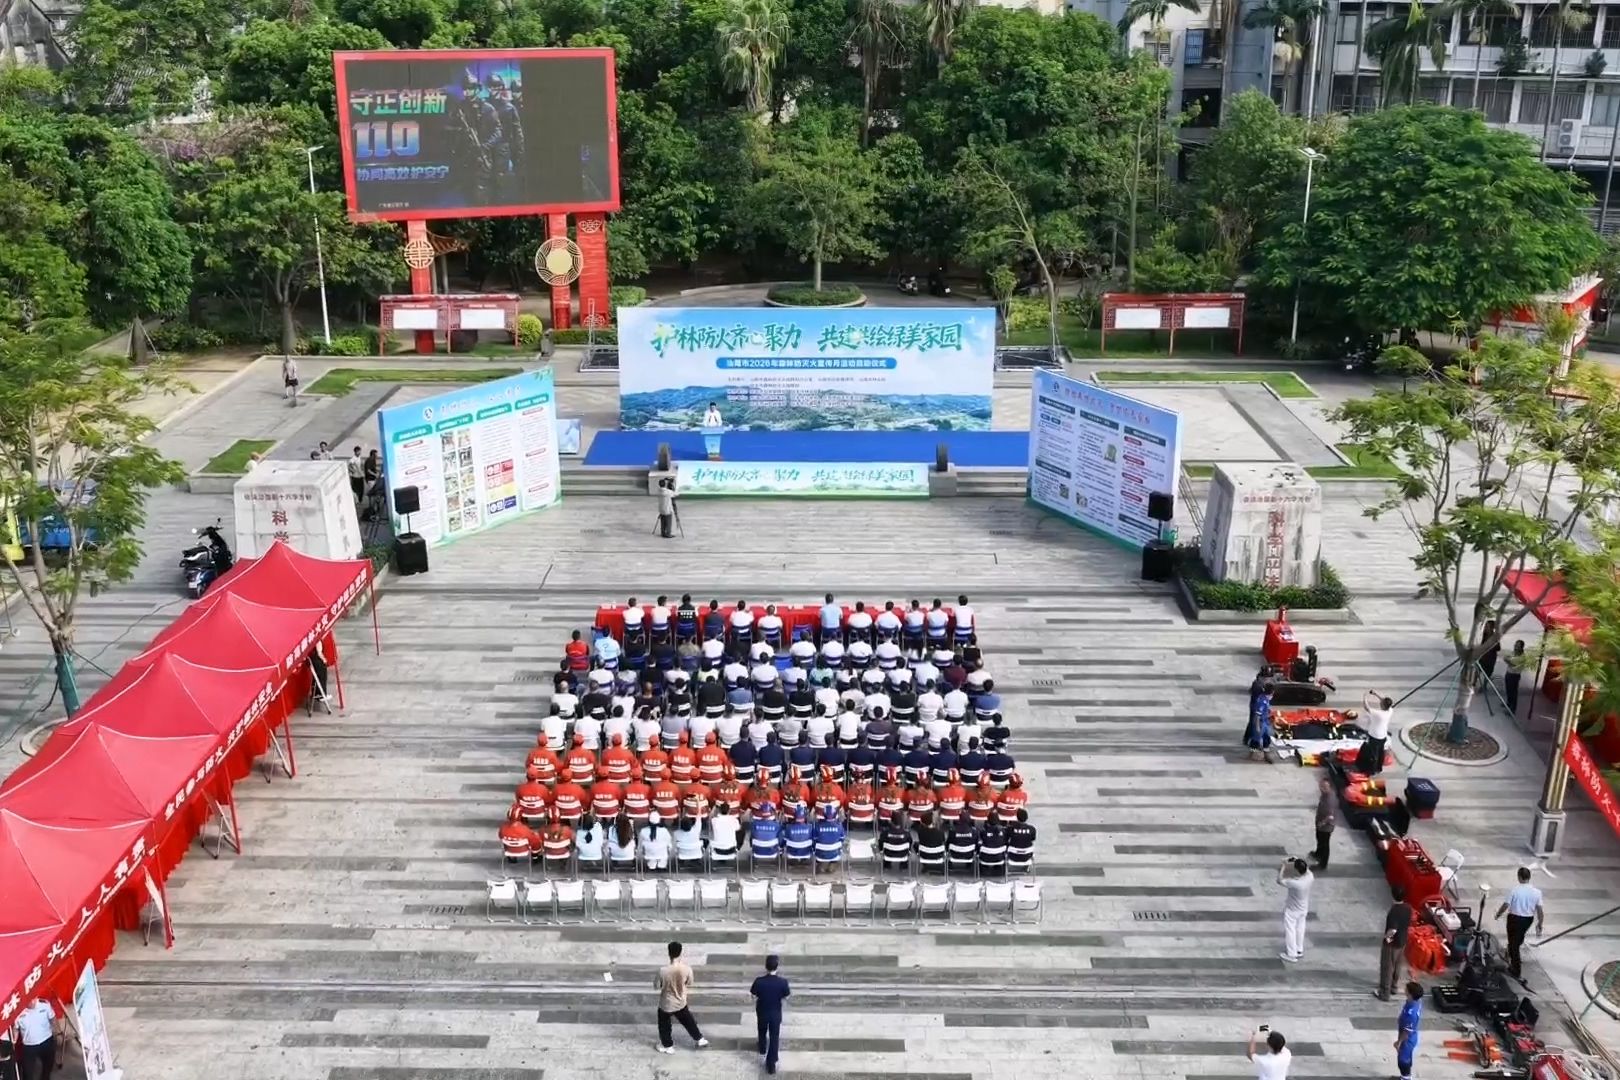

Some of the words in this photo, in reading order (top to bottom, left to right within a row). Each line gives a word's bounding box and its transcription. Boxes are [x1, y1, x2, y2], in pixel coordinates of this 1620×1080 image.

[350, 88, 447, 116] 守正创新
[352, 121, 421, 158] 110
